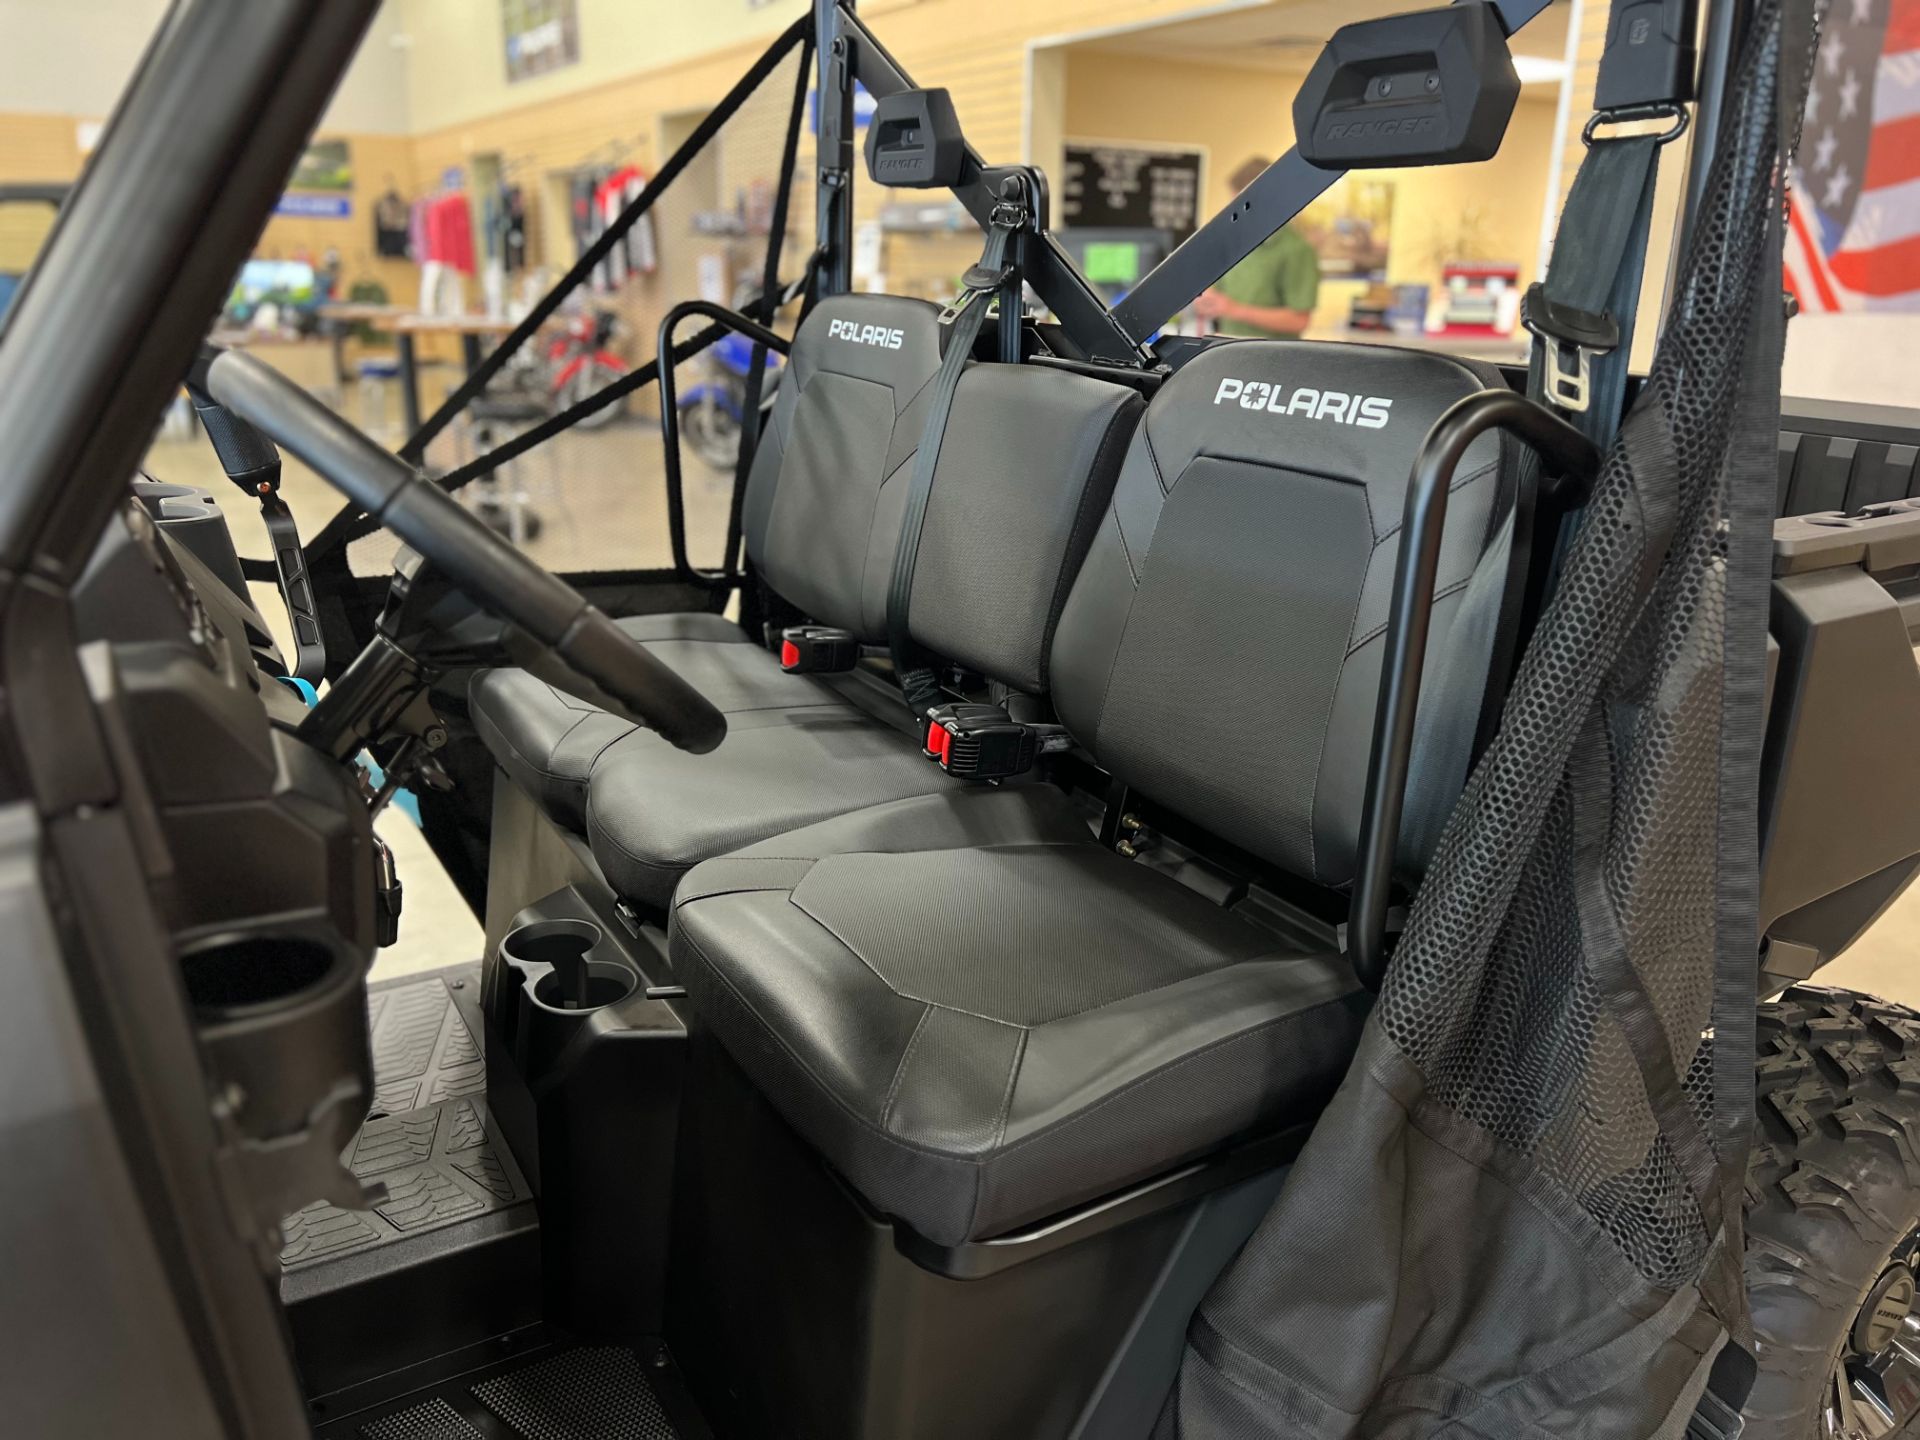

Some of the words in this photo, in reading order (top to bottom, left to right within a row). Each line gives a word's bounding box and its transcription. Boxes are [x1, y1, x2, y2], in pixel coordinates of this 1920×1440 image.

[1325, 115, 1436, 140] RANGER
[828, 319, 904, 350] POLARIS
[1213, 377, 1394, 429] POLARIS
